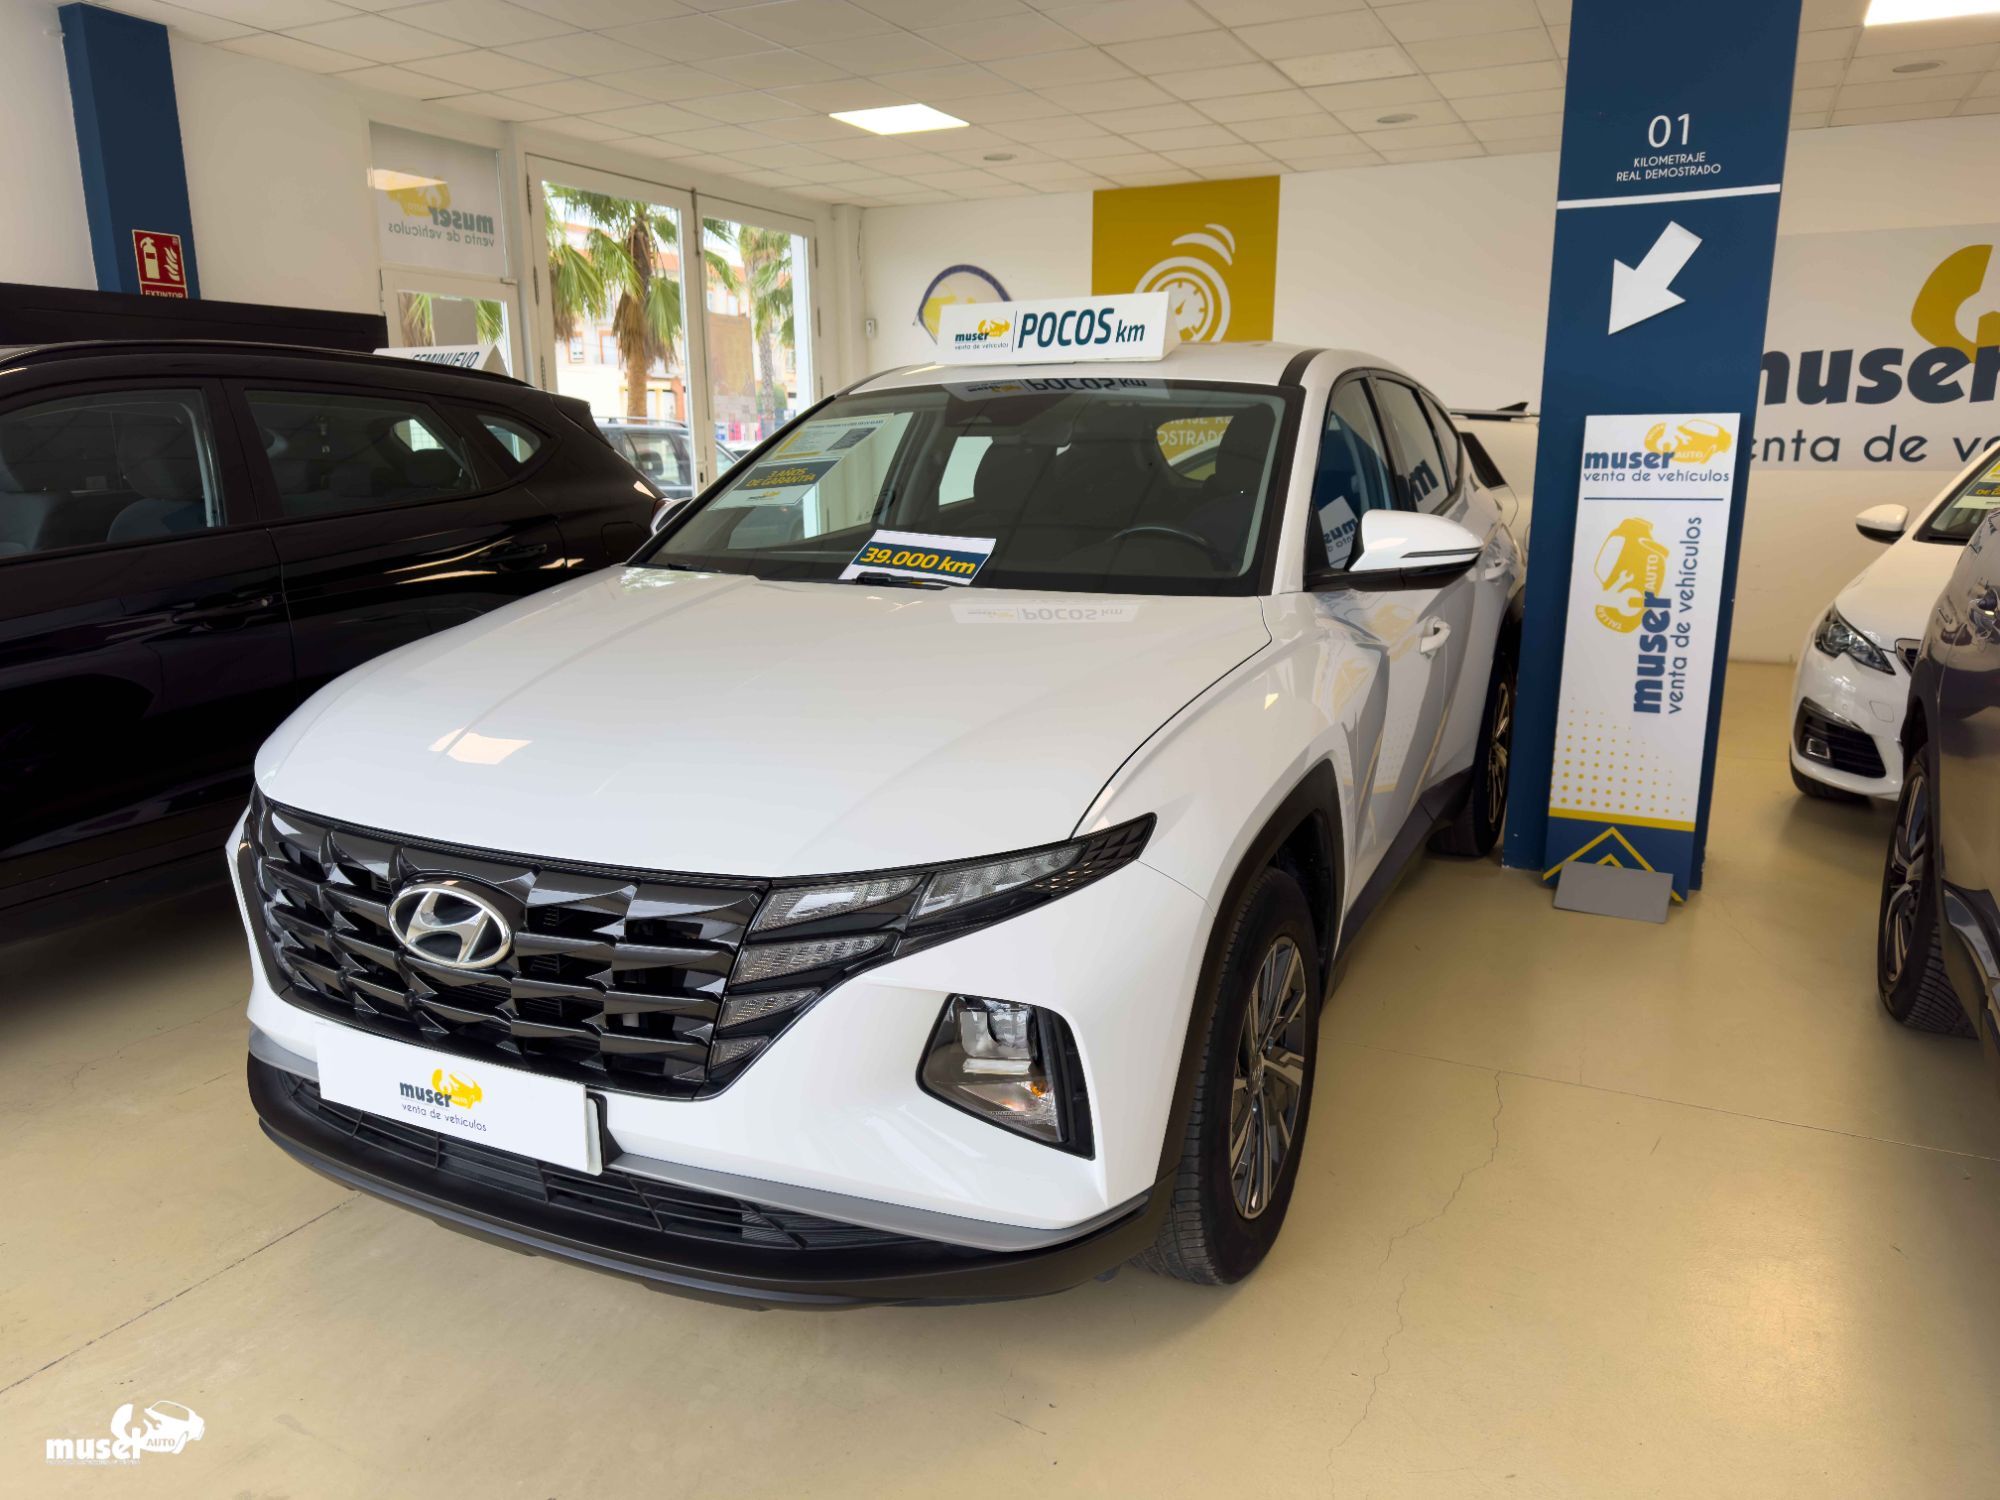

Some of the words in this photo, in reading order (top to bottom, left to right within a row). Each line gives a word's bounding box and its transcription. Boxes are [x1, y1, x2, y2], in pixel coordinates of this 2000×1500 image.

[1648, 113, 1690, 148] 01
[1616, 171, 1642, 182] REAL
[1645, 163, 1722, 180] DEMOSTRADO
[1633, 152, 1706, 168] KILOMETRAJE
[955, 332, 989, 342] muser
[1018, 307, 1115, 349] POCOS
[1115, 319, 1146, 344] km
[1750, 429, 1841, 463] nta
[1863, 424, 1929, 463] de
[1584, 451, 1675, 470] muser
[1584, 471, 1626, 482] venta
[1631, 469, 1651, 482] de
[1658, 468, 1730, 482] vehículos
[860, 546, 939, 568] 39.000
[937, 556, 976, 575] km
[1644, 554, 1659, 590] AUTO
[1675, 516, 1703, 613] vehículos
[1670, 622, 1691, 648] de
[1633, 591, 1672, 714] muser
[1668, 656, 1688, 714] venta
[399, 1082, 452, 1108] muser
[401, 1103, 427, 1116] venta
[430, 1108, 442, 1120] de
